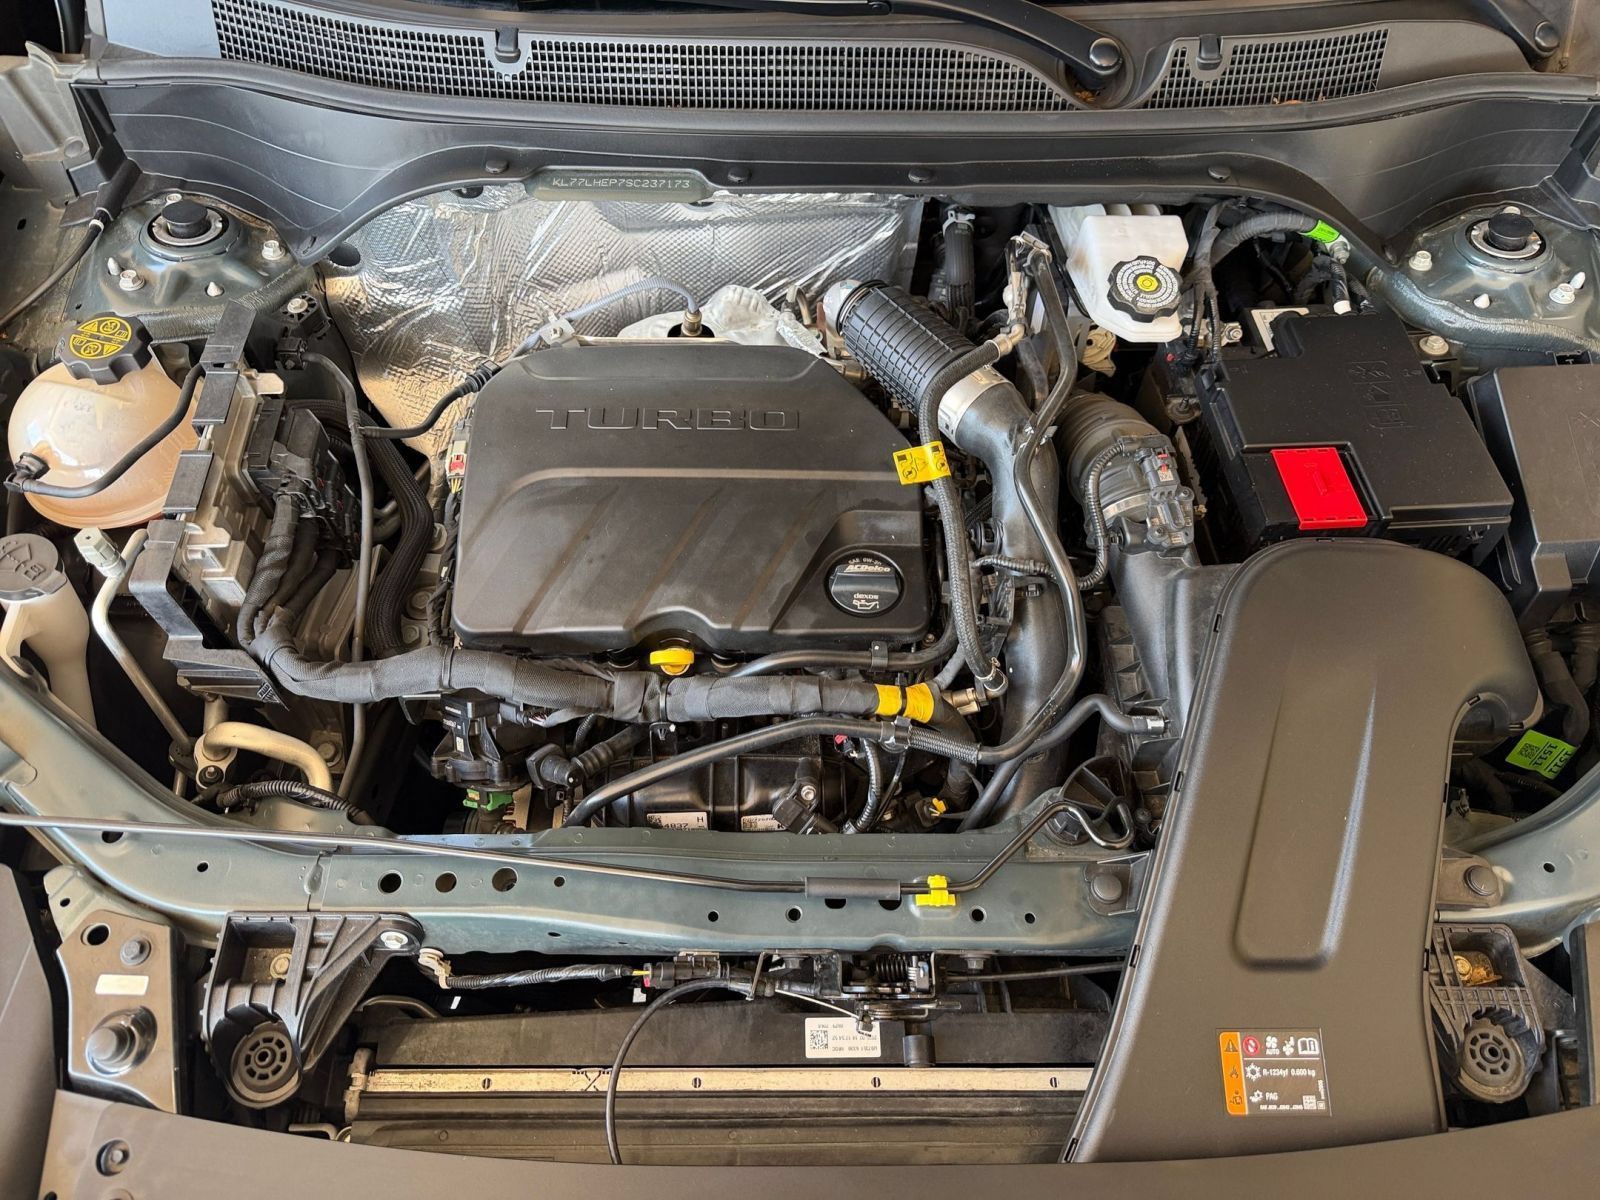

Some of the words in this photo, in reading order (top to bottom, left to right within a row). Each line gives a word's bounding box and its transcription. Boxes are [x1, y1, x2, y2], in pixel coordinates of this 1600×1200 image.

[552, 177, 690, 188] KL77LHEP7SC237173
[535, 407, 800, 431] TURBO
[1532, 743, 1558, 767] 1511
[1262, 1068, 1288, 1077] R-1234yf
[1307, 1068, 1315, 1077] kg
